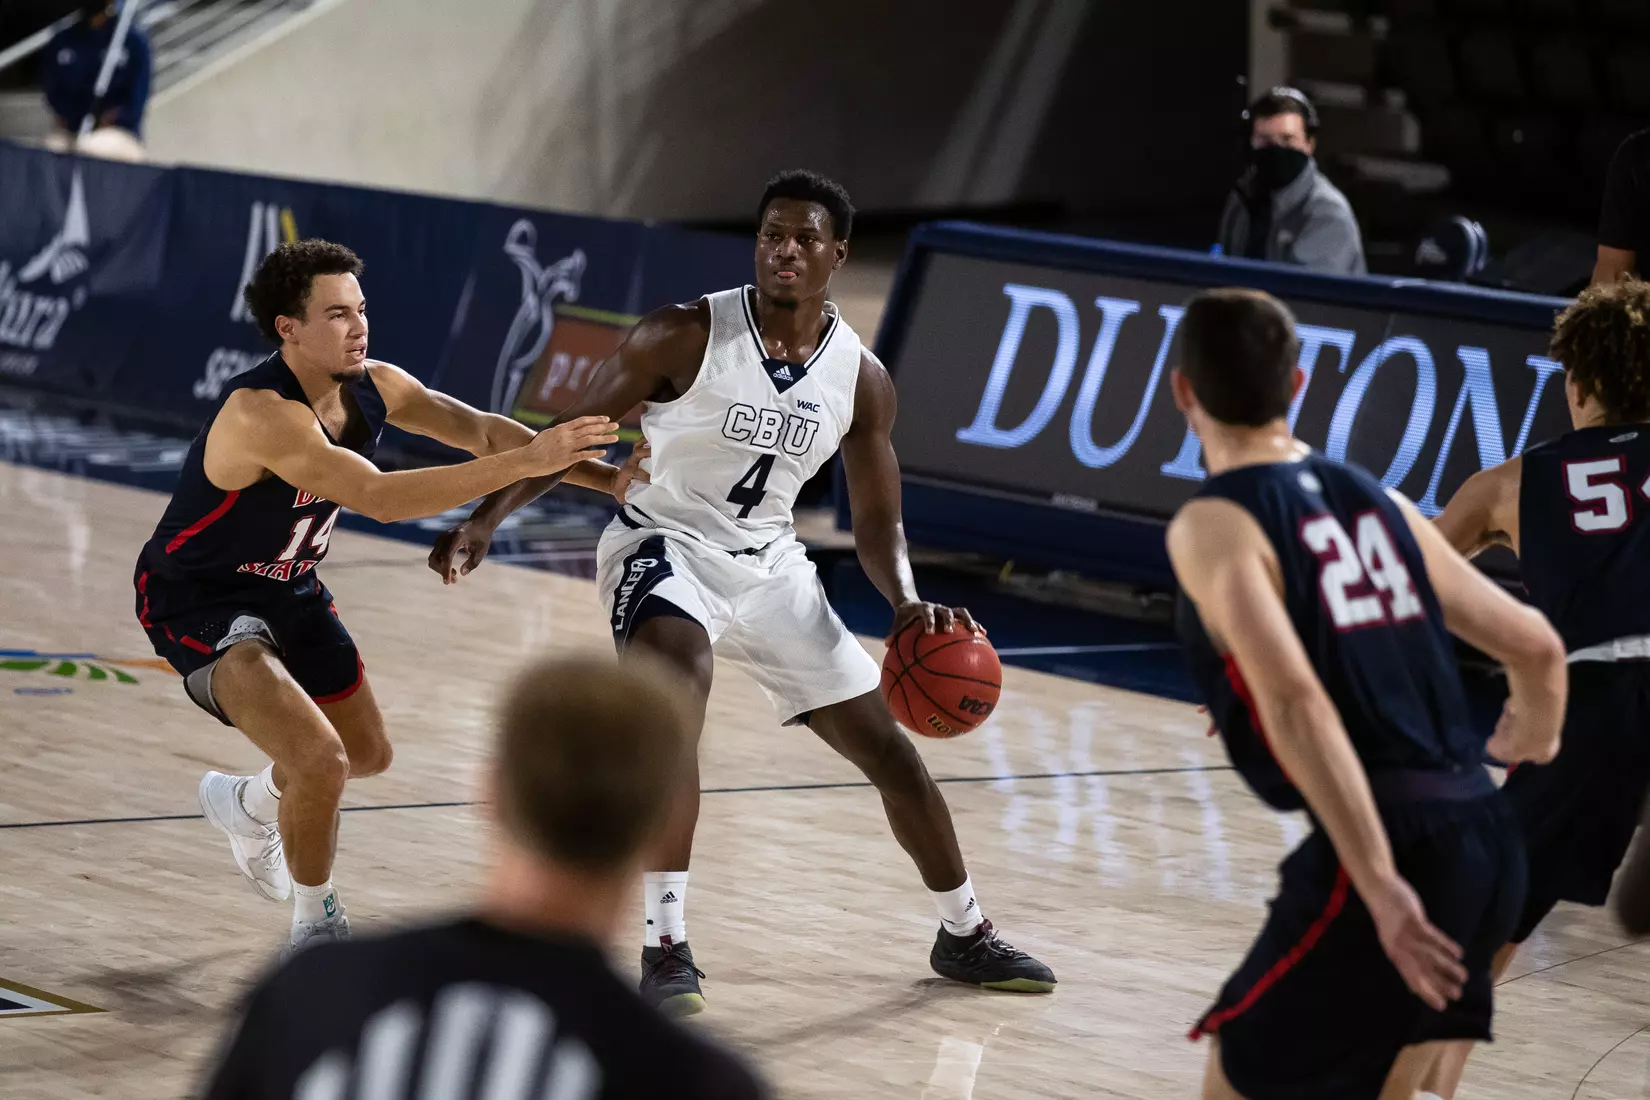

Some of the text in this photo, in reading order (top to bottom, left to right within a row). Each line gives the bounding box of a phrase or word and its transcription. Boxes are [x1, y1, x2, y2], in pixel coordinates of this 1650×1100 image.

[773, 372, 794, 382] adidas
[797, 399, 820, 413] WAC
[957, 283, 1566, 518] DUTON
[722, 403, 820, 456] CBU
[726, 453, 776, 519] 4
[1562, 455, 1650, 534] 5
[275, 506, 340, 561] 14
[1300, 511, 1424, 630] 24
